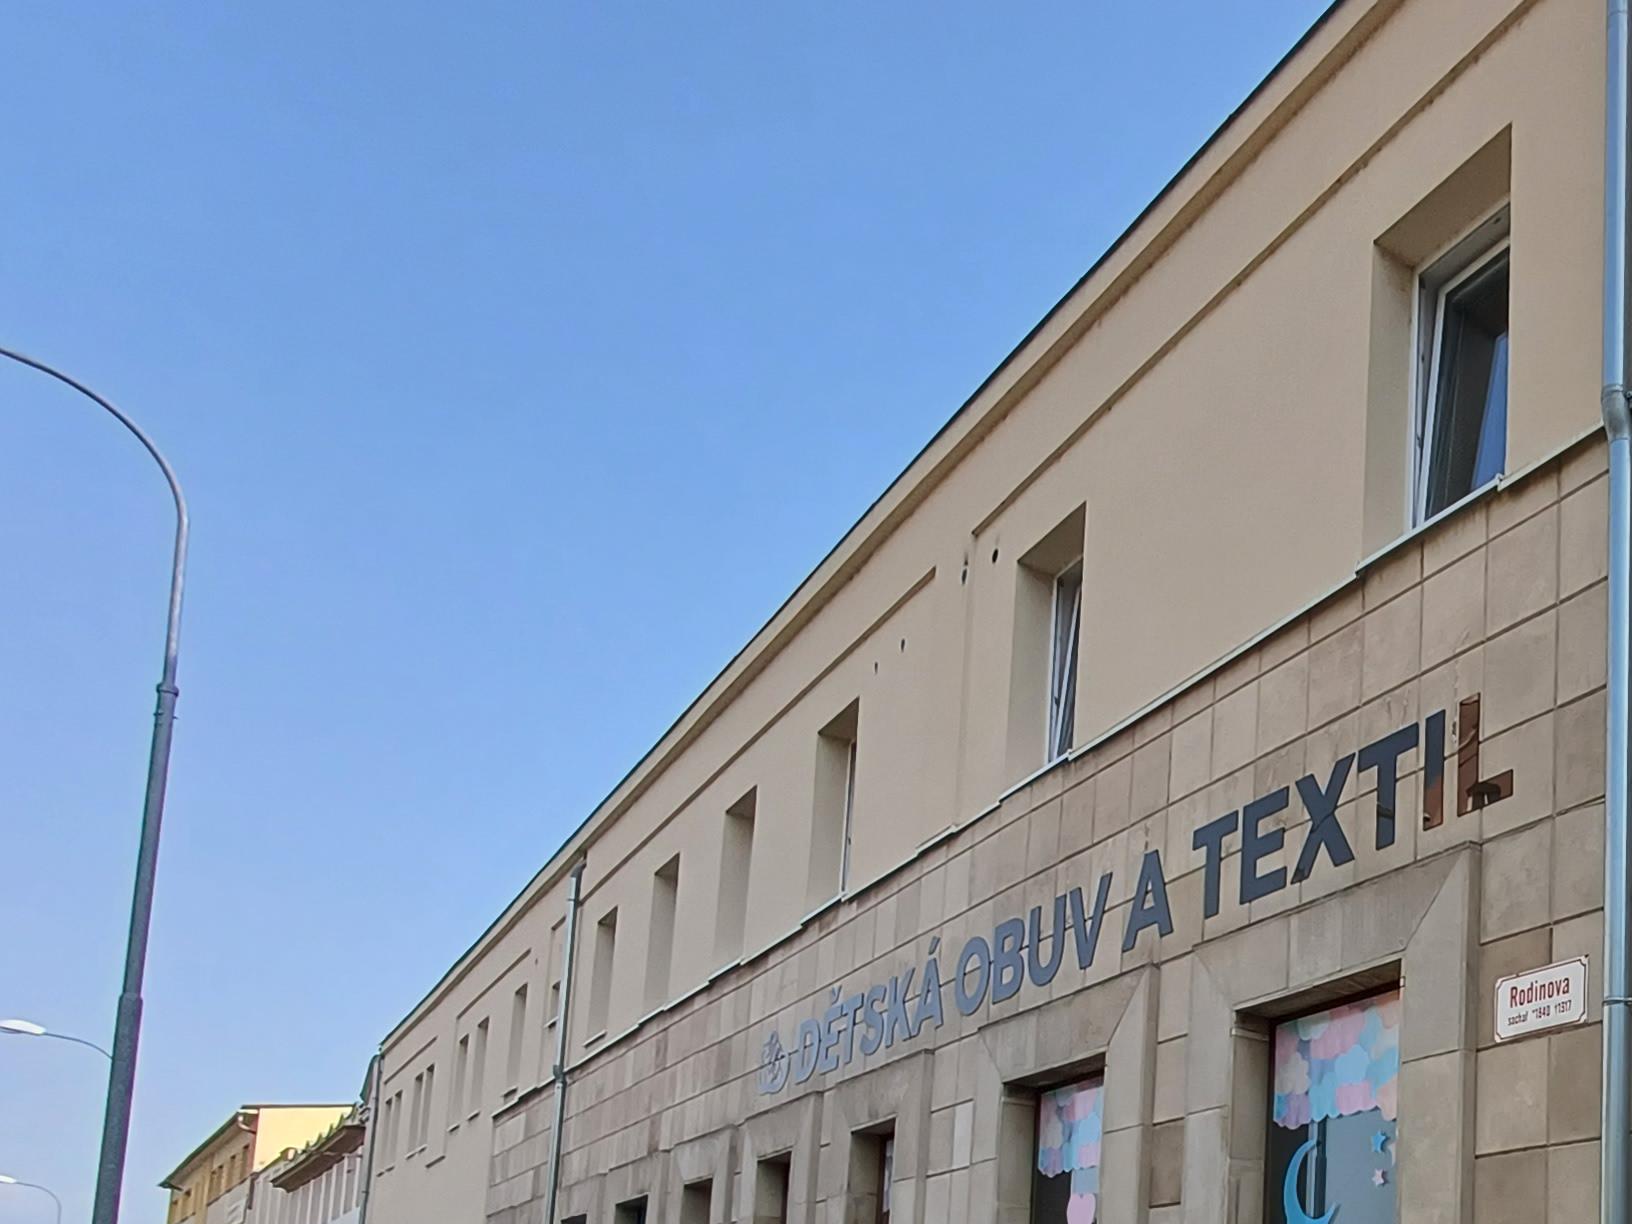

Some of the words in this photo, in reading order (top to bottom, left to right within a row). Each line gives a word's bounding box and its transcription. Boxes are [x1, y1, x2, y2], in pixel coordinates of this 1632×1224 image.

[795, 935, 944, 1086] DĚTSKÁ
[954, 871, 1113, 1017] OBUV
[1122, 848, 1174, 953] A
[1193, 692, 1514, 920] TEXTIL
[1509, 977, 1570, 1008] Rodinova
